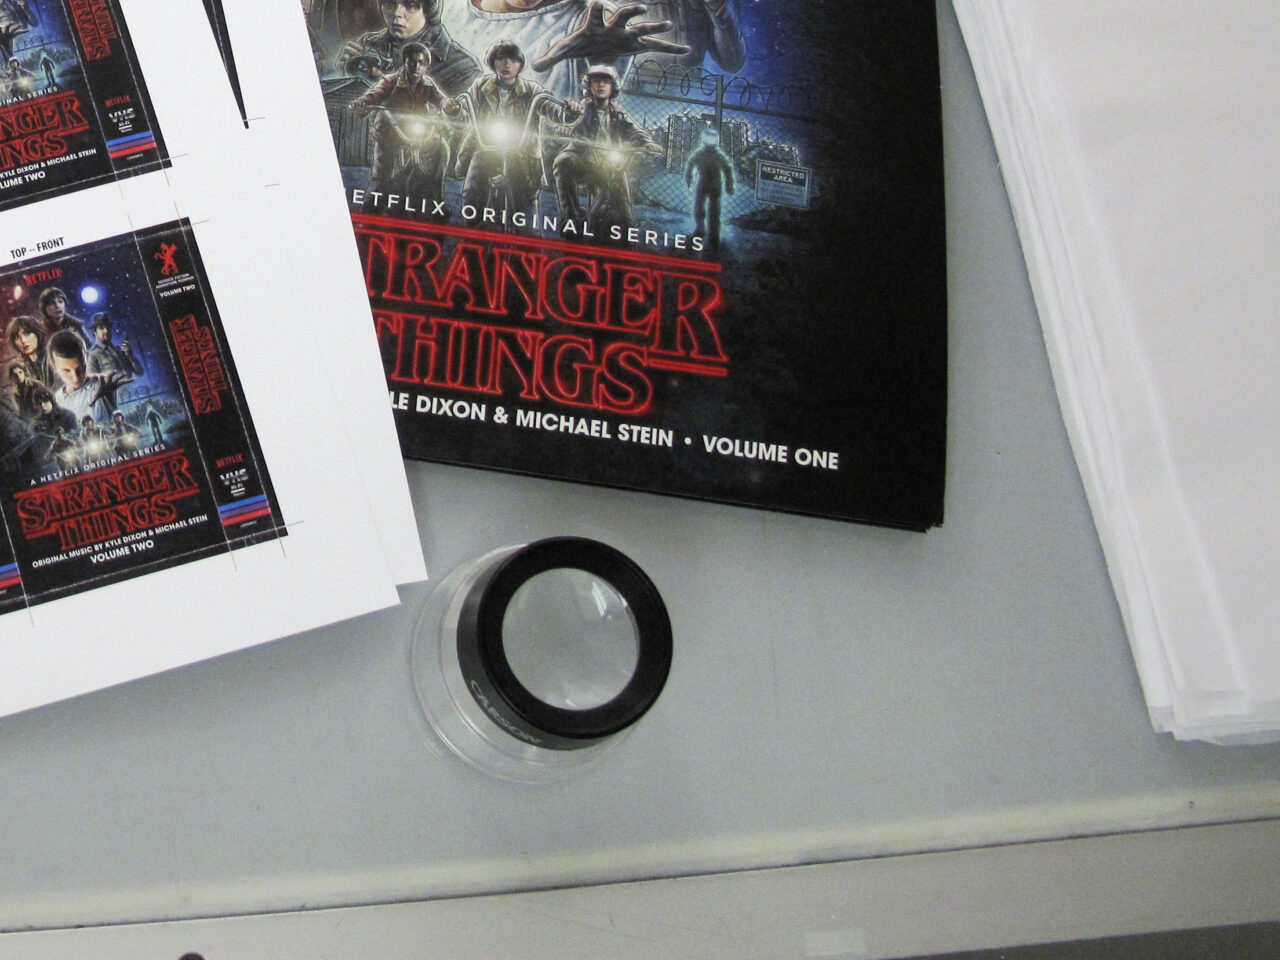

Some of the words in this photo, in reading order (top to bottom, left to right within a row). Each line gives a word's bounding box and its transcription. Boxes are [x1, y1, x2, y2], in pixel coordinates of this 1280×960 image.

[26, 85, 58, 99] SERIES
[15, 162, 40, 174] DIXON
[39, 160, 46, 168] &
[45, 152, 78, 166] MICHAEL
[77, 147, 97, 158] STEIN
[762, 166, 805, 179] RESTRICTED
[23, 169, 46, 183] TWO
[773, 174, 793, 184] AREA
[352, 188, 447, 217] ETFLIX
[461, 204, 595, 237] ORIGINAL
[609, 224, 705, 252] SERIES
[9, 246, 29, 260] TOP
[35, 236, 66, 253] FRONT
[24, 266, 62, 286] NETFLIX
[159, 287, 183, 299] VOLUME
[182, 284, 197, 293] TWO
[354, 220, 728, 368] TRANGER
[371, 308, 654, 414] THINGS
[389, 390, 409, 412] LE
[416, 394, 487, 423] DIXON
[493, 405, 509, 425] &
[516, 409, 611, 440] MICHAEL
[618, 423, 674, 448] STEIN
[703, 433, 788, 464] VOLUME
[794, 446, 840, 470] ONE
[28, 478, 36, 486] A
[39, 466, 79, 483] NETFLIX
[82, 453, 129, 471] ORIGINAL
[132, 443, 166, 458] SERIES
[12, 446, 200, 539] STRANGER
[50, 490, 178, 551] THINGS
[30, 552, 68, 568] ORIGINAL
[67, 545, 93, 558] MUSIC
[93, 542, 103, 551] BY
[103, 537, 122, 549] KYLE
[122, 530, 148, 544] DIXON
[147, 528, 154, 537] &
[154, 519, 188, 535] MICHAEL
[188, 513, 209, 525] STEIN
[89, 544, 131, 564] VOLUME
[130, 538, 155, 553] TWO
